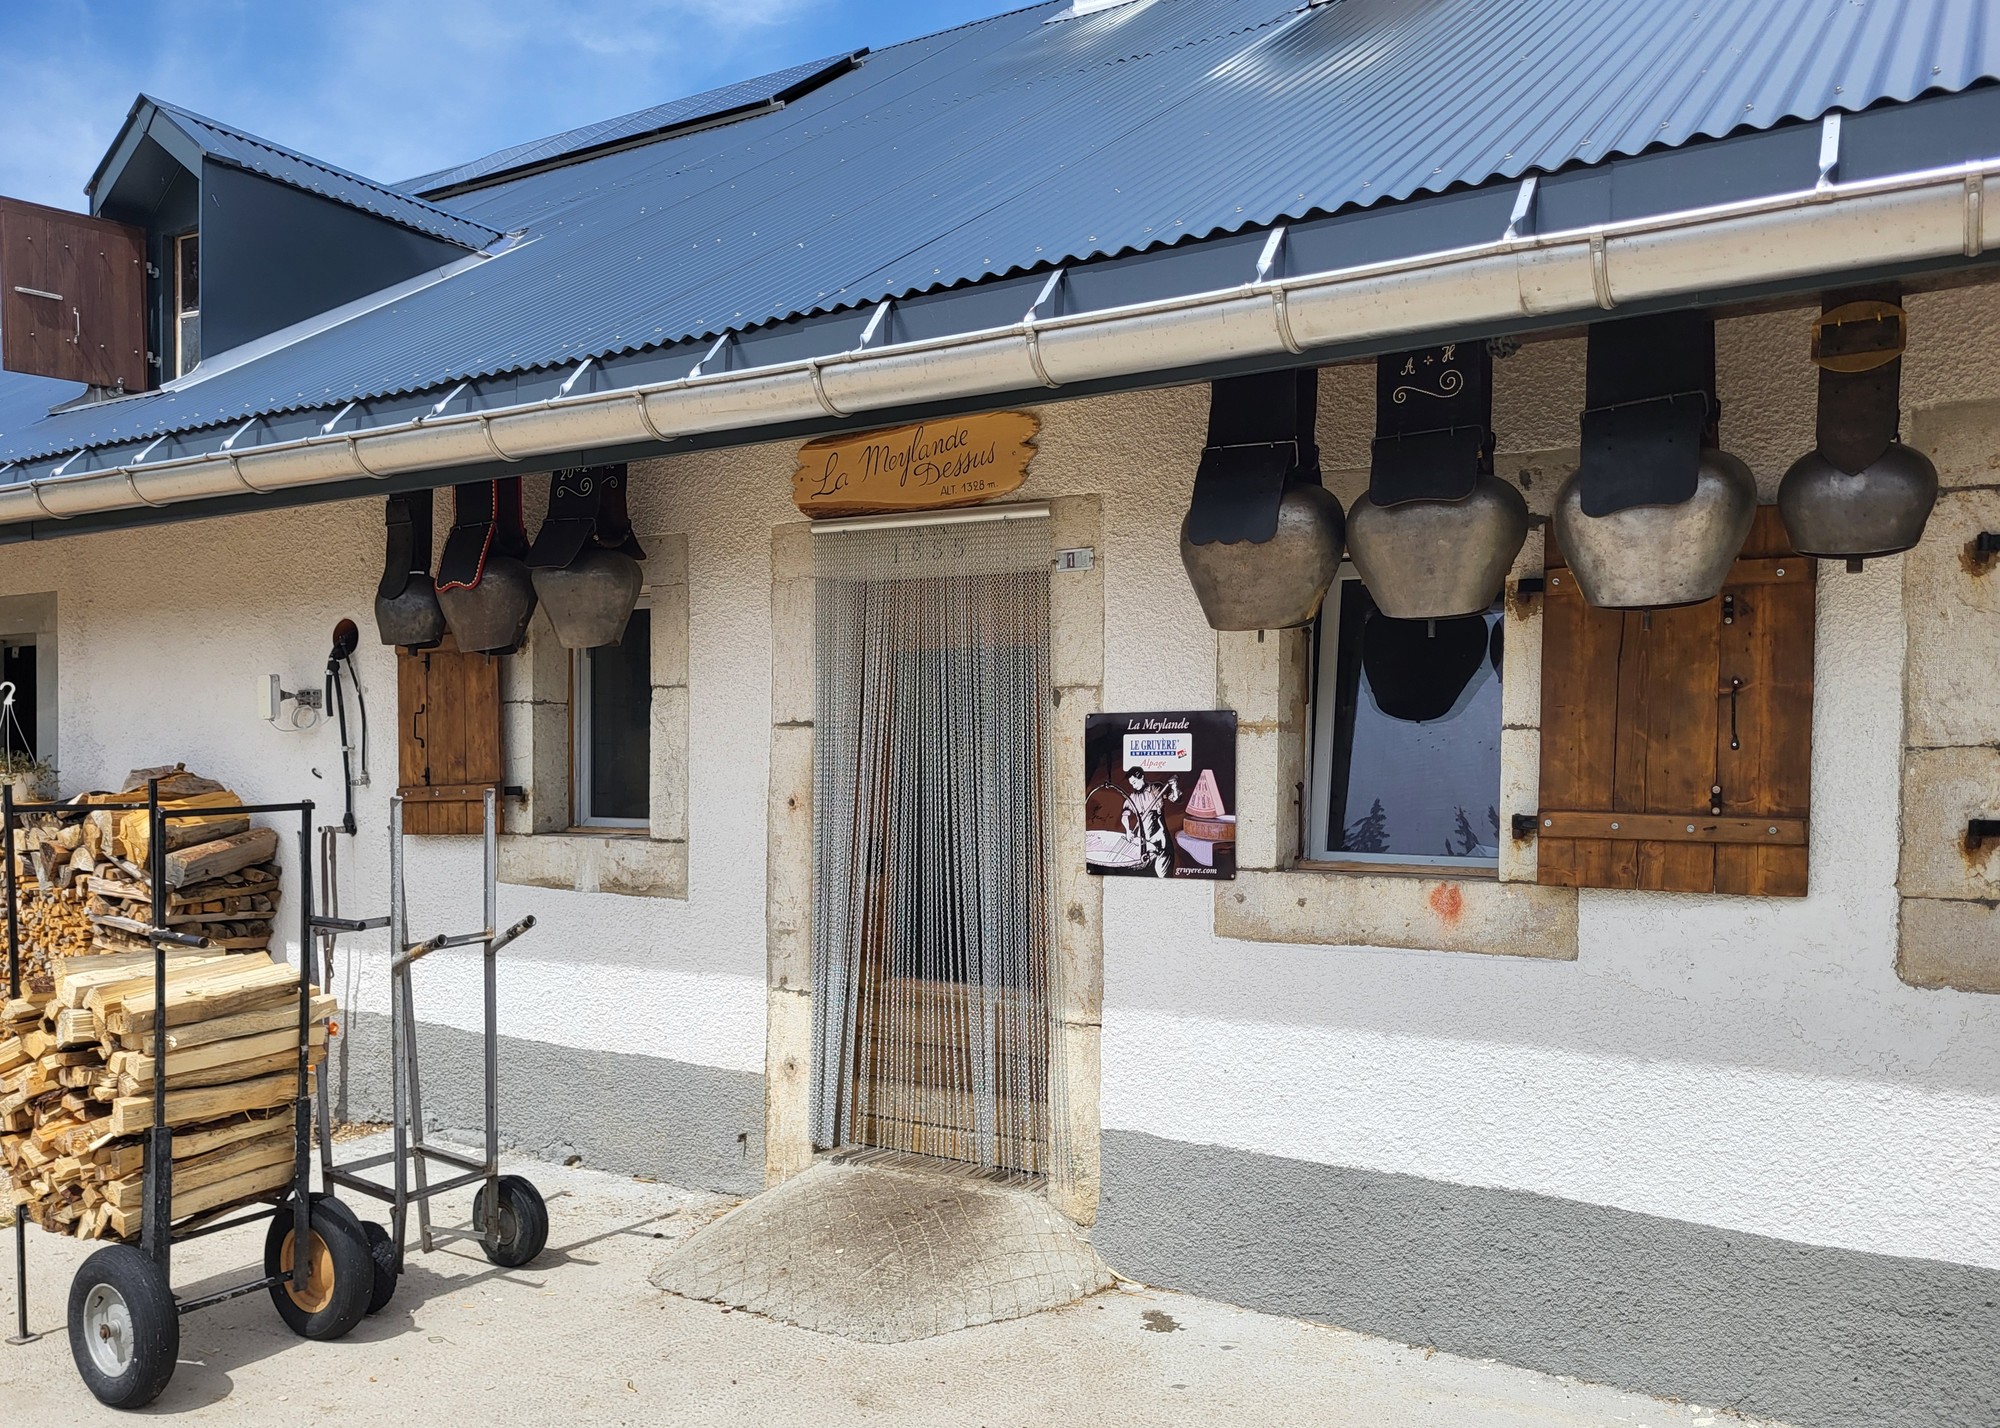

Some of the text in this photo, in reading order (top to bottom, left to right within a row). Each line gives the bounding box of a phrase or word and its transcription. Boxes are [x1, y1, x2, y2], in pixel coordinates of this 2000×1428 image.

[1400, 356, 1416, 376] A
[810, 425, 969, 500] La Meylande
[913, 441, 996, 487] Dessus
[940, 484, 957, 497] ALT.
[961, 479, 985, 493] 1328
[1127, 717, 1190, 733] La Meylande
[1130, 737, 1177, 751] LE GRUYÈRE
[1140, 758, 1167, 769] Alpage
[1175, 867, 1218, 876] gruyere.com
